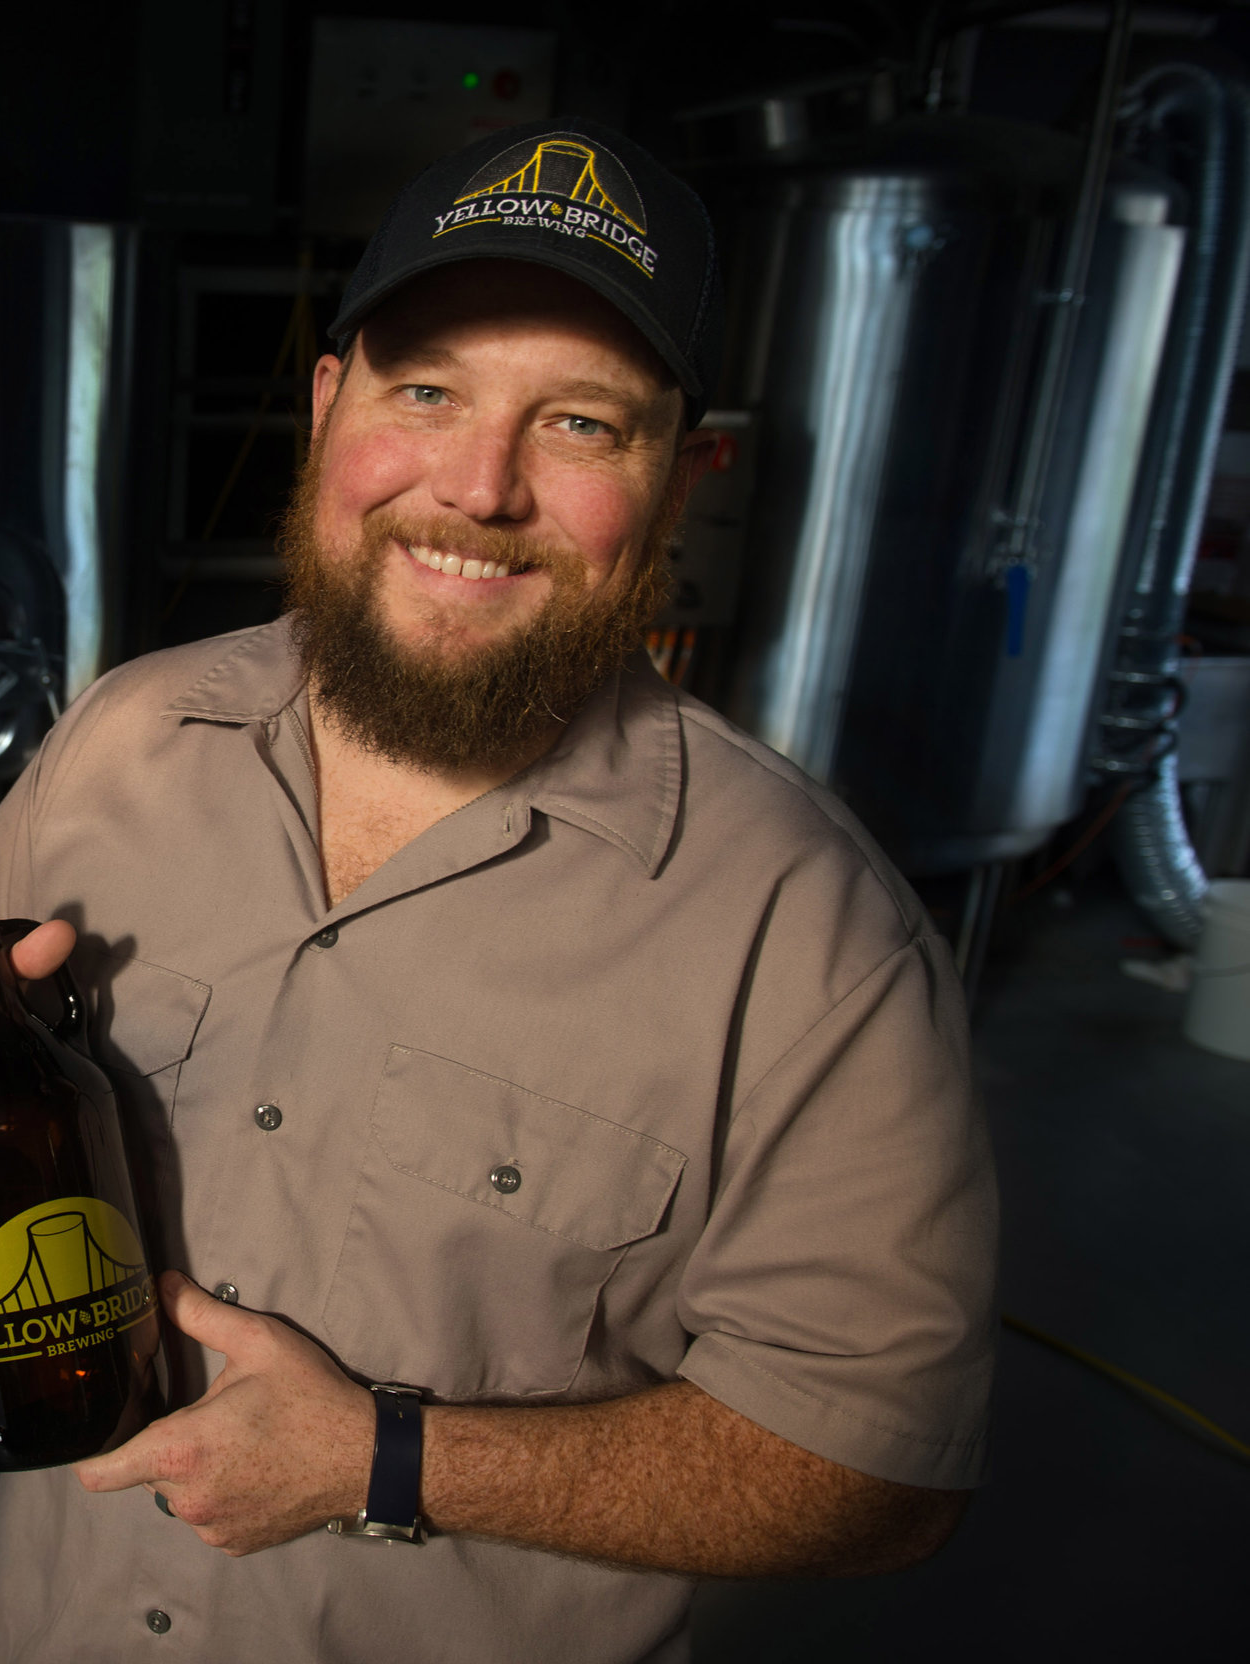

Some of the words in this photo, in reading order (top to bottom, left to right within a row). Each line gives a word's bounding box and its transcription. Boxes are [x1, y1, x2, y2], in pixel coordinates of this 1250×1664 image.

[434, 198, 553, 235] YELLOW
[564, 206, 659, 273] BRIDGE
[502, 216, 587, 239] BREWING
[46, 1327, 116, 1358] BREWING
